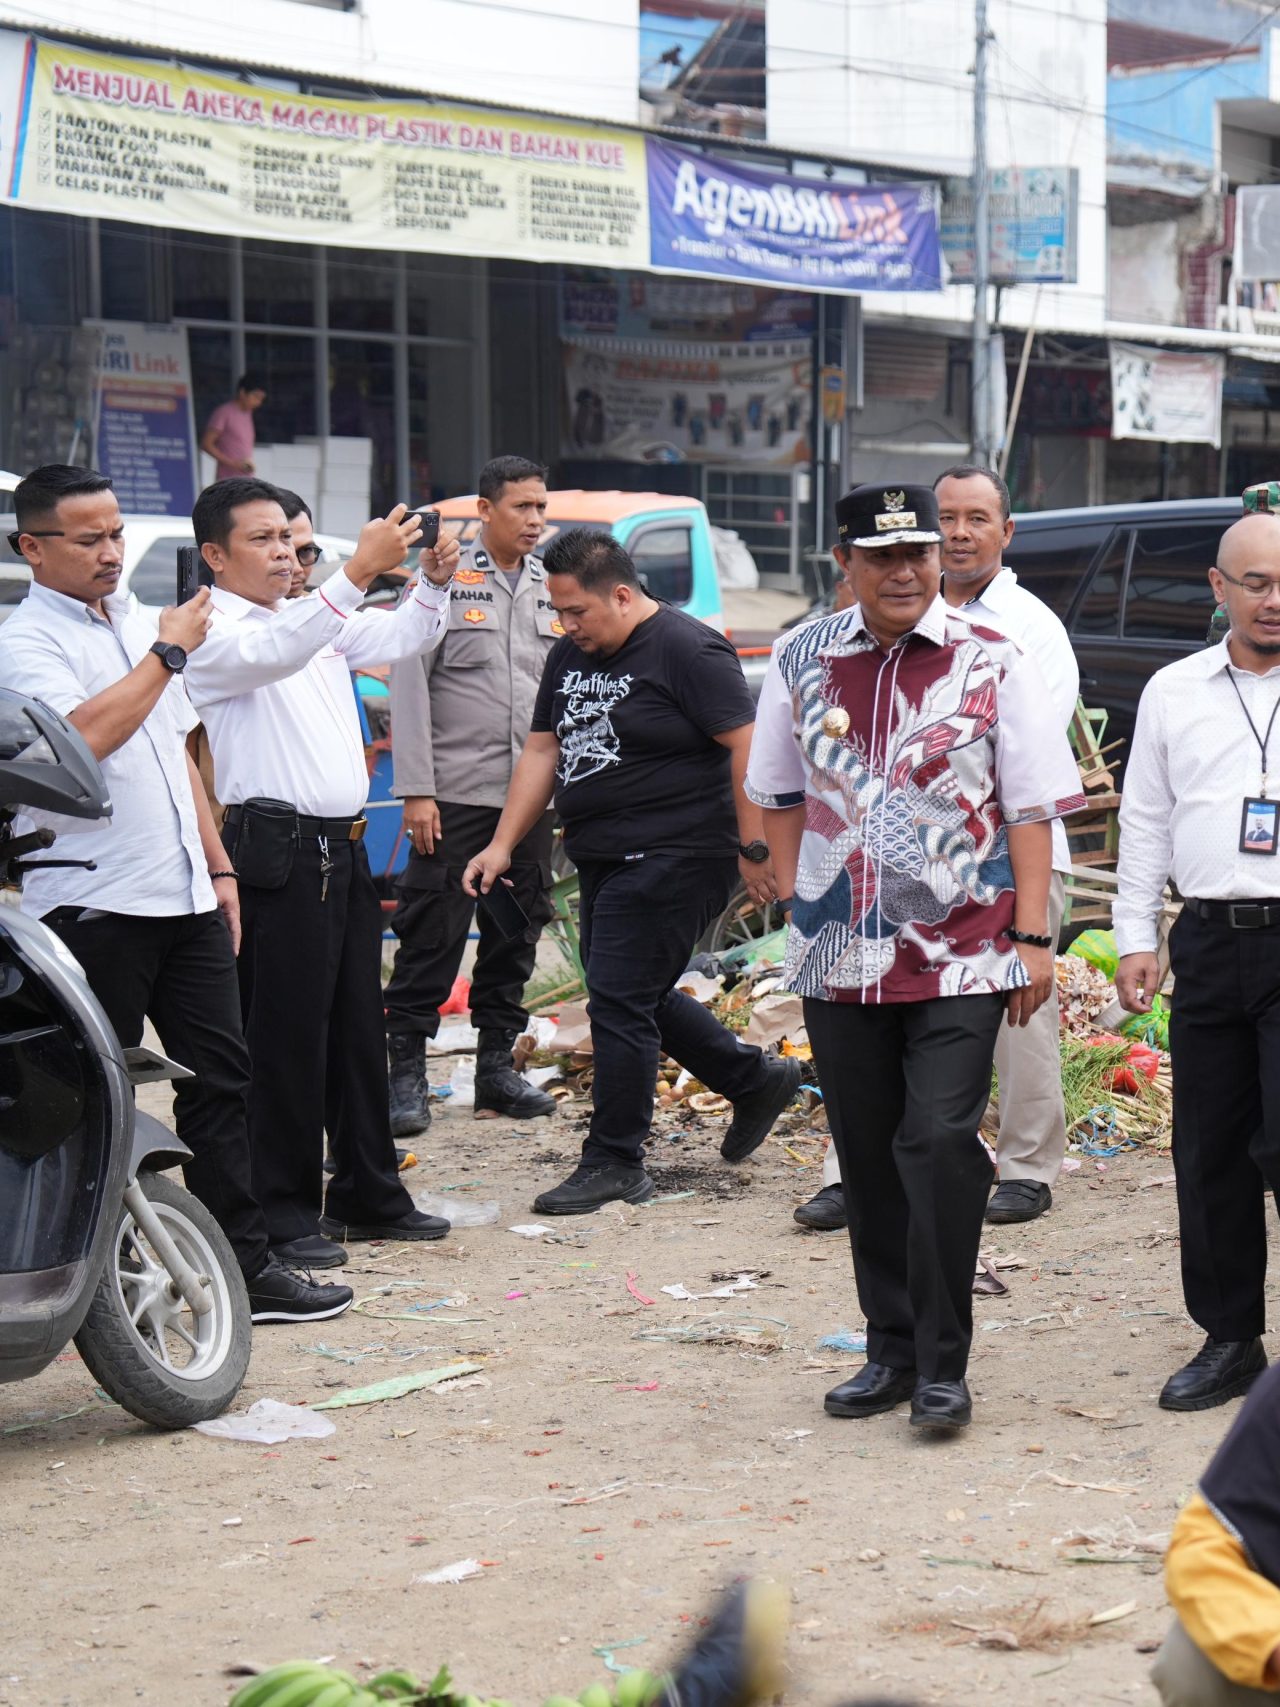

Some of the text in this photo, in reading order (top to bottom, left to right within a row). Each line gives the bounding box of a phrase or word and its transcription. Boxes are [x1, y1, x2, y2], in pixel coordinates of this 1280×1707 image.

[54, 63, 624, 167] MENJUAL ANEKA MACAM PLASTIK DAN BAHAN KUE
[55, 128, 114, 148] FROZEN
[154, 129, 212, 149] PLASTIK
[55, 158, 133, 180] MAKANAN
[104, 184, 165, 201] PLASTIK
[296, 193, 349, 209] PLASTIK
[301, 207, 353, 223] PLASTIK
[133, 352, 181, 375] Link
[450, 589, 494, 603] KAHAR
